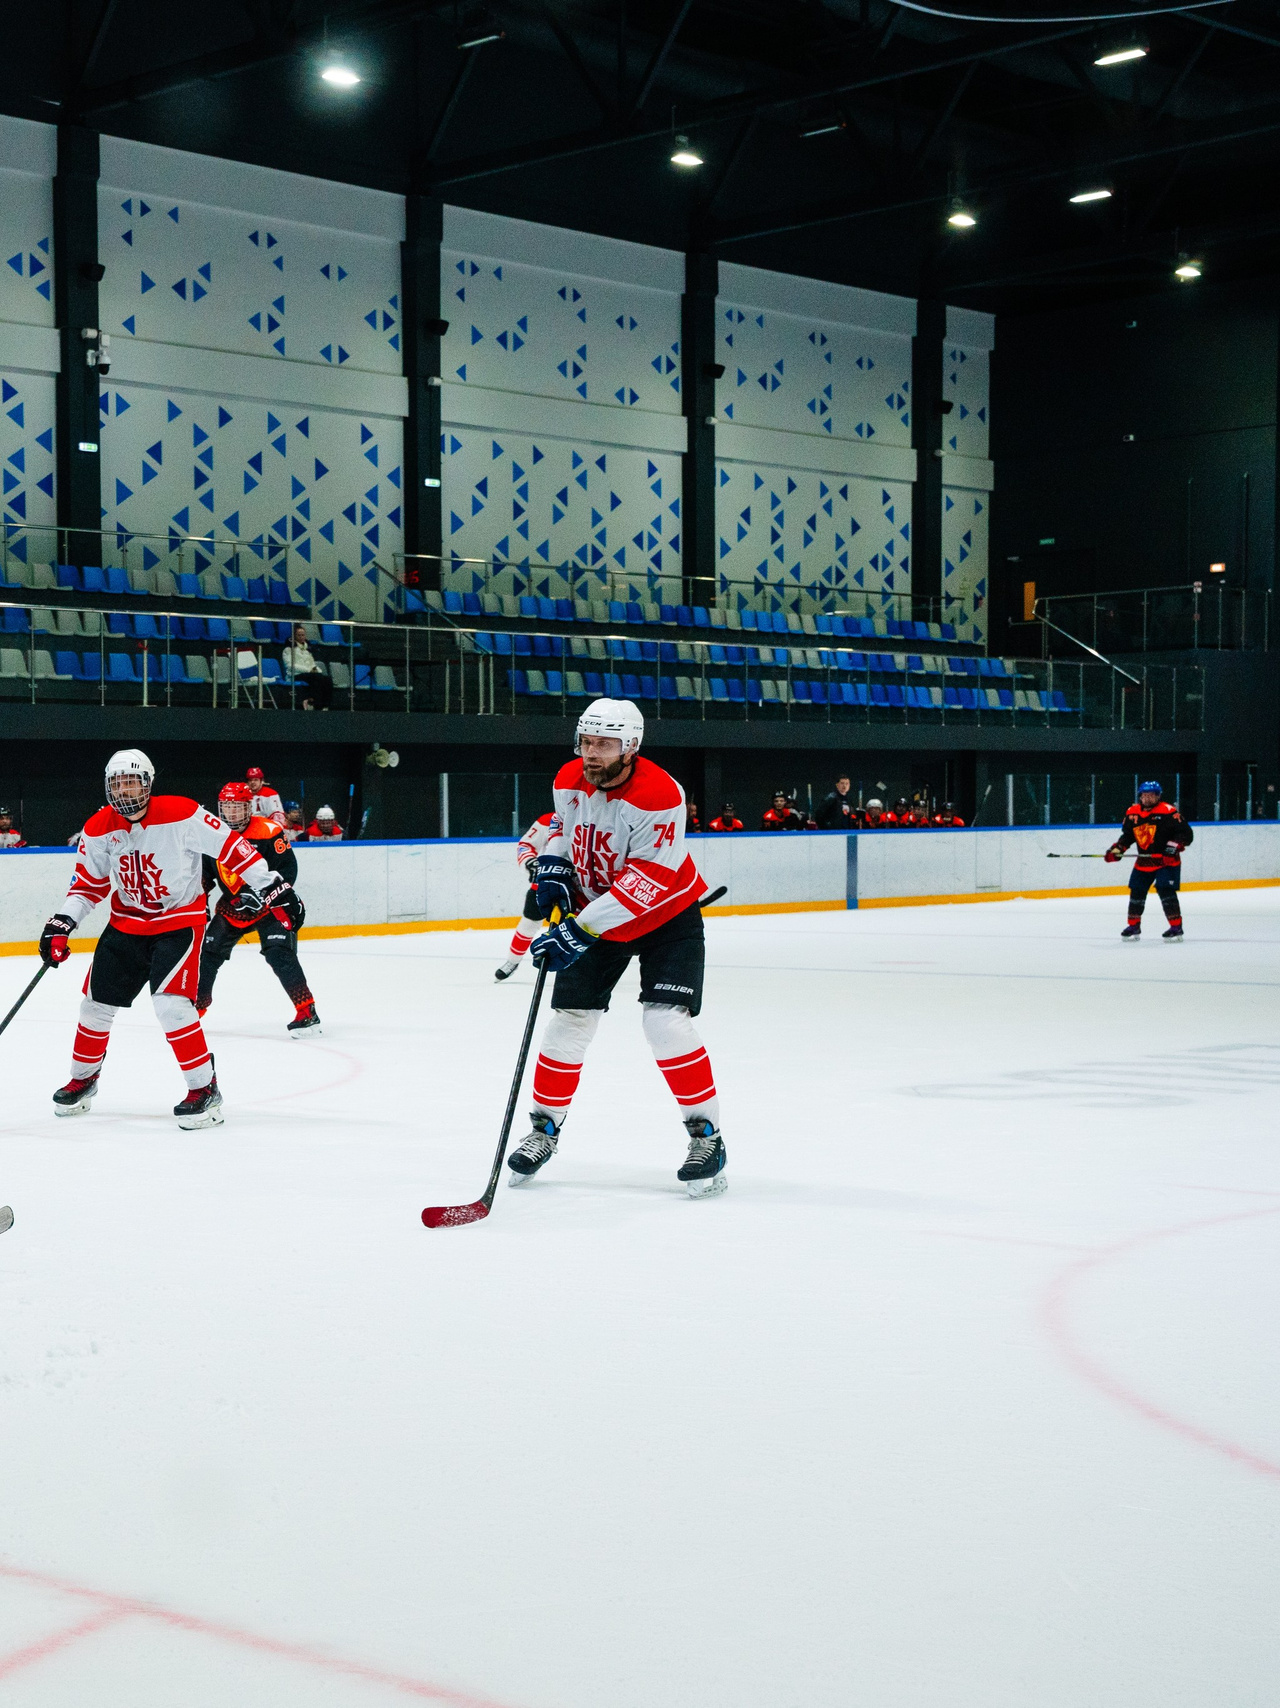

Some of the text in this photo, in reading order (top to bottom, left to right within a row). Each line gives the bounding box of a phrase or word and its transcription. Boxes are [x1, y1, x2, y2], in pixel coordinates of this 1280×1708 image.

[653, 822, 675, 848] 74
[633, 886, 655, 905] WAY
[637, 879, 661, 898] SILK
